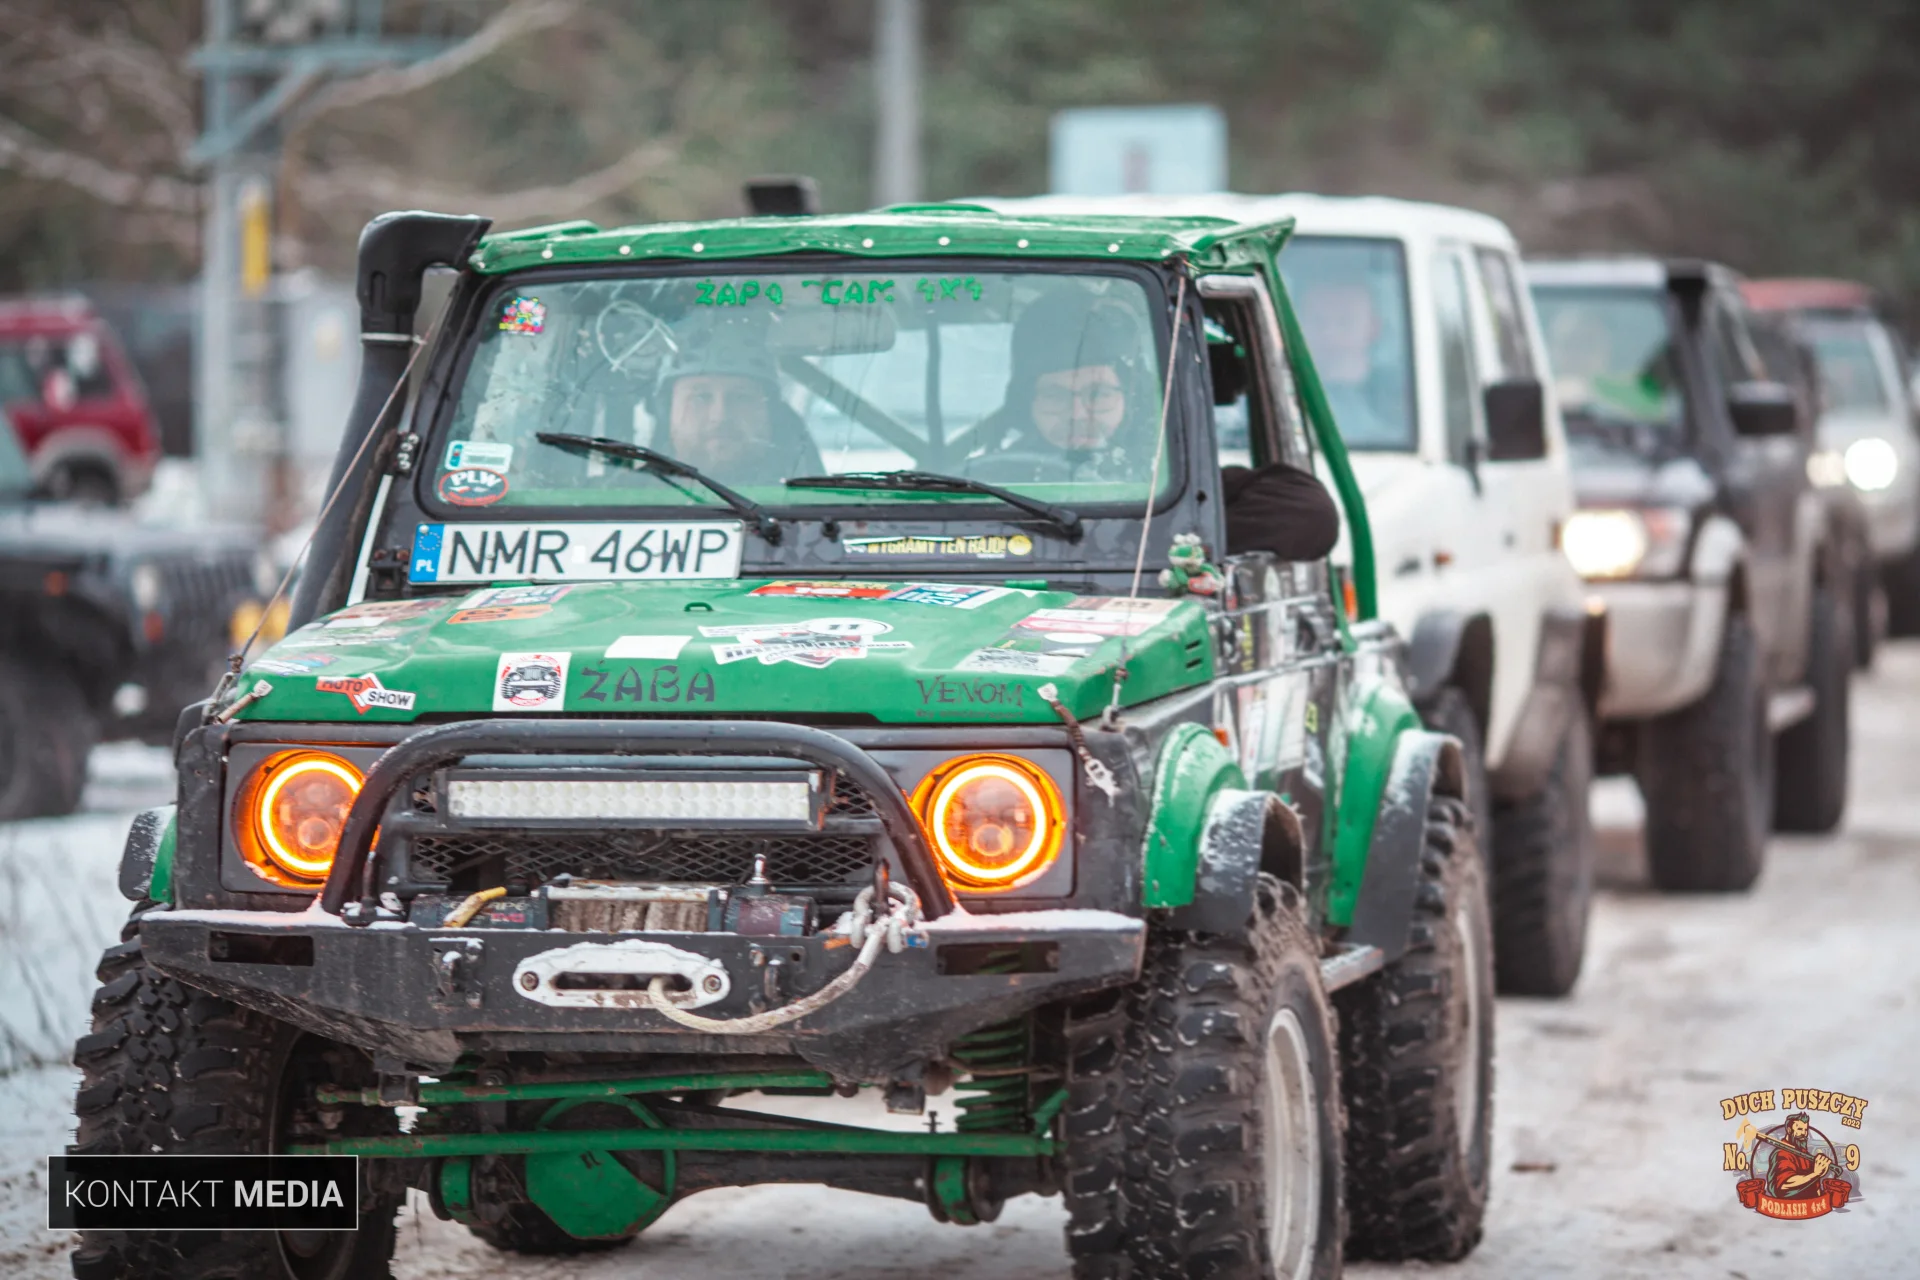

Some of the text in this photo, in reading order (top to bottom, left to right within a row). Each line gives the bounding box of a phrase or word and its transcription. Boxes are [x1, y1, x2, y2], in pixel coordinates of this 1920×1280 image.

[448, 528, 729, 575] NMR 46WP
[415, 558, 436, 573] PL
[367, 690, 411, 707] SHOW
[915, 674, 1024, 708] VENOM
